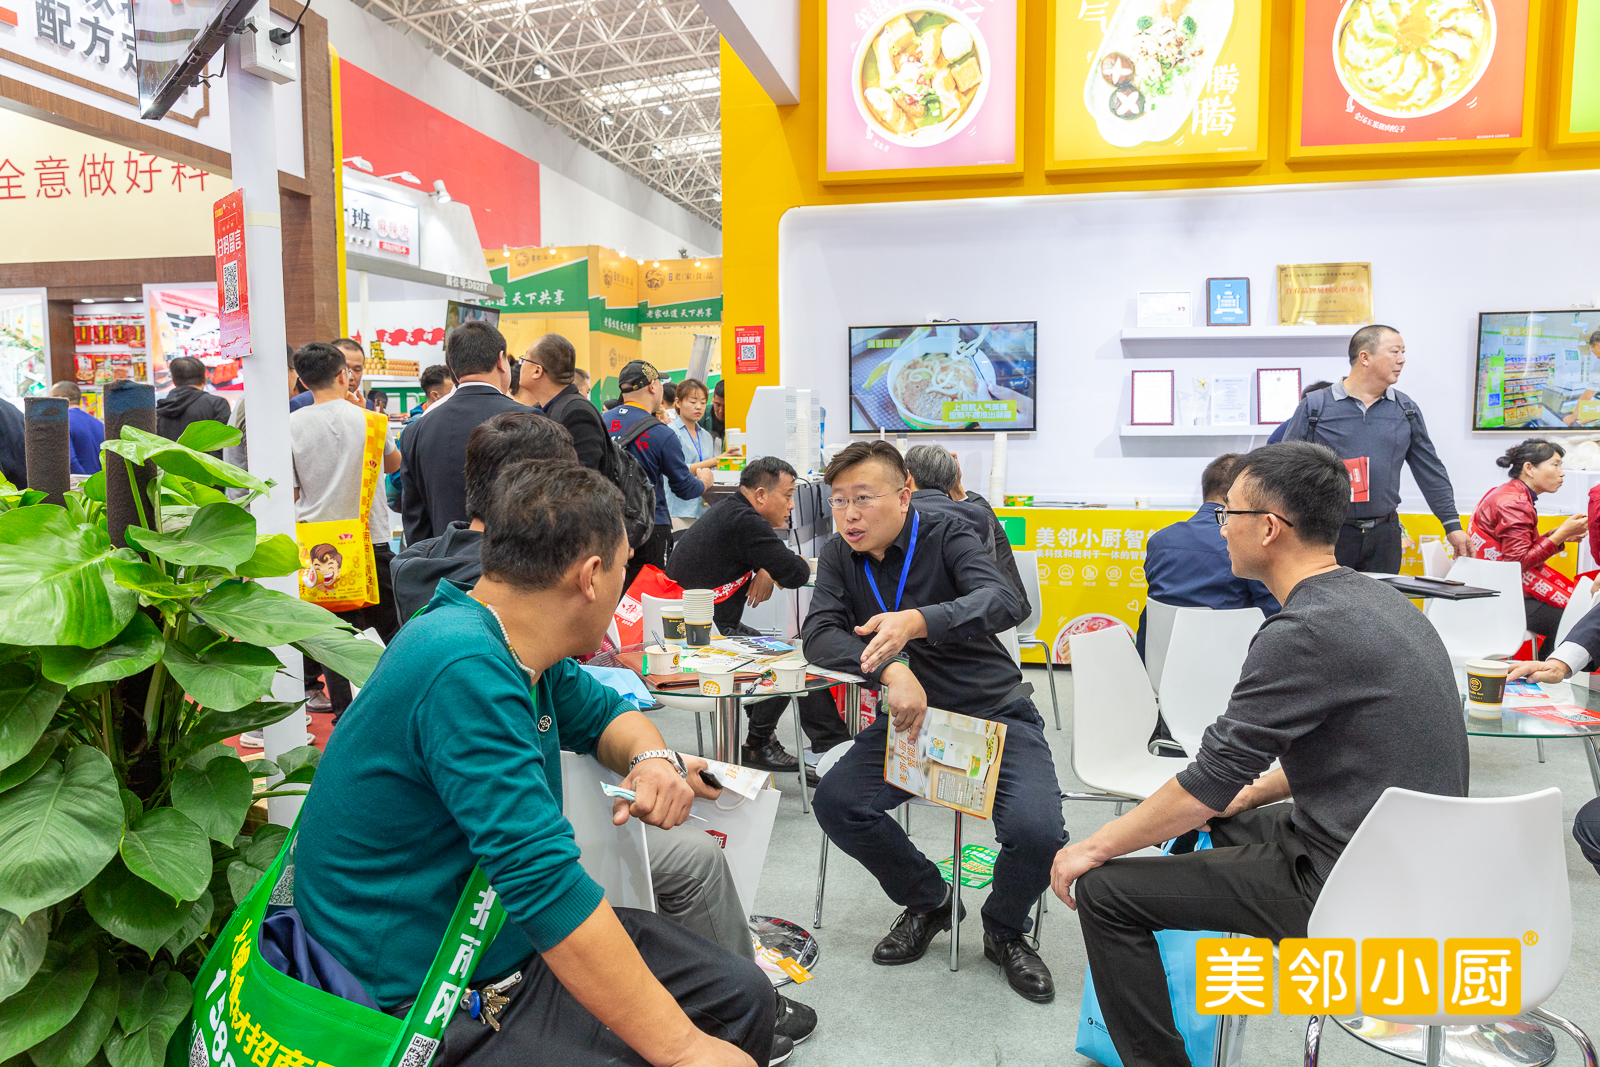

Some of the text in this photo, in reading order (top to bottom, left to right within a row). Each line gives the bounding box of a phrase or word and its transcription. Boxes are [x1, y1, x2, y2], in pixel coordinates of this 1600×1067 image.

[1191, 63, 1240, 137] 腾腾
[217, 229, 242, 258] 扫码留言
